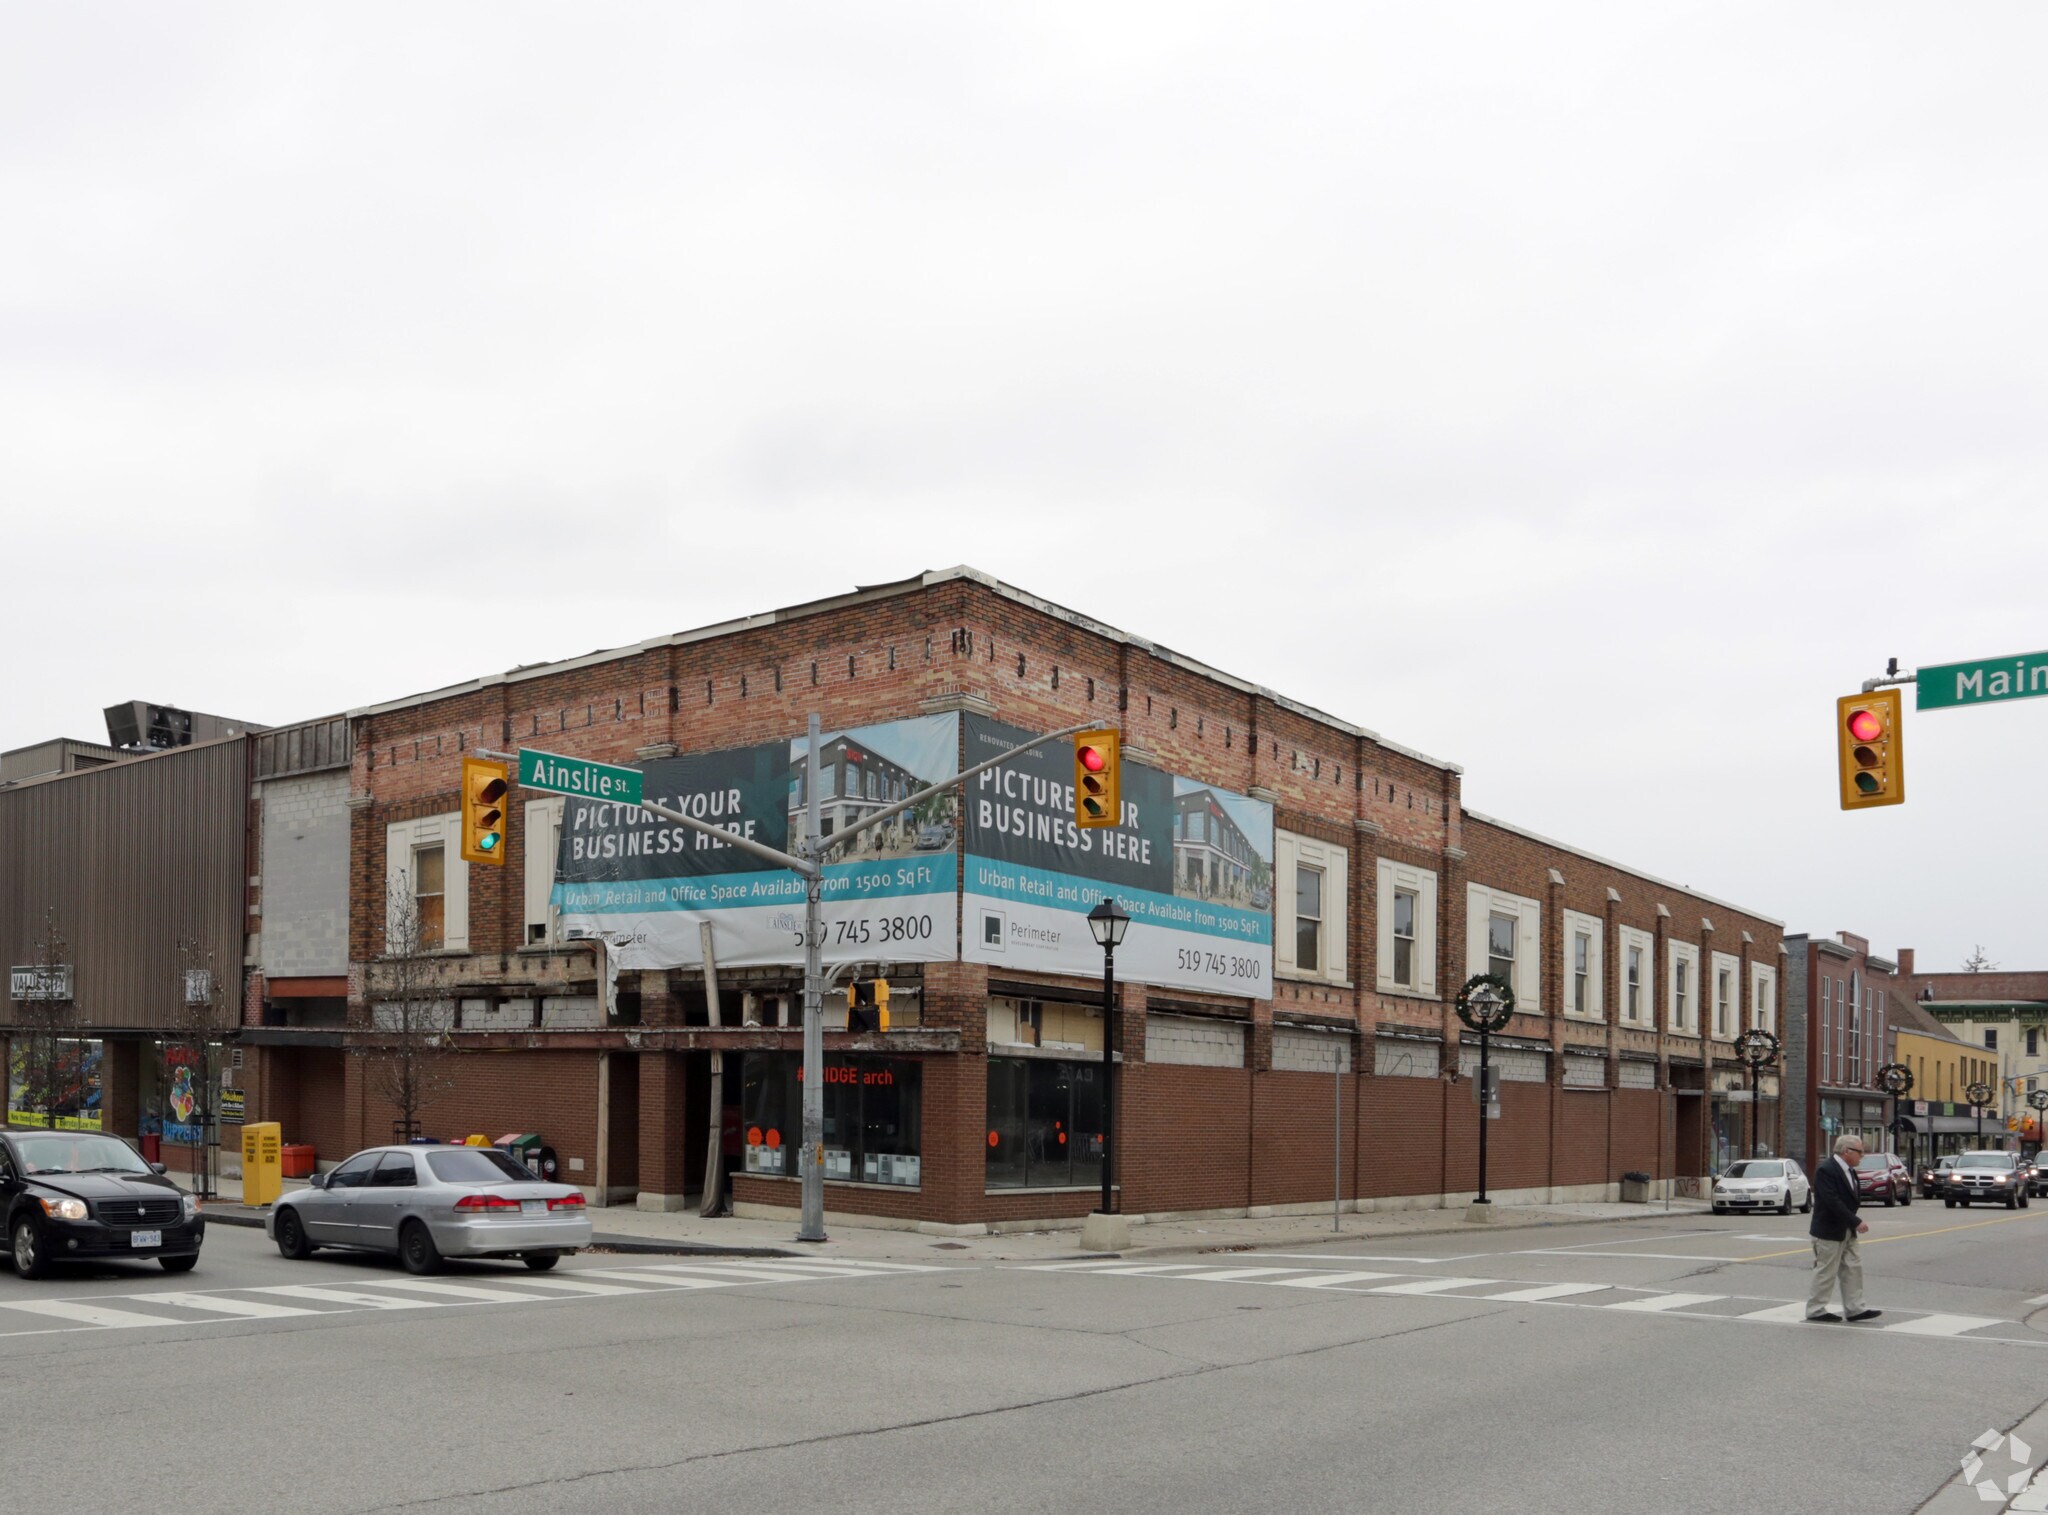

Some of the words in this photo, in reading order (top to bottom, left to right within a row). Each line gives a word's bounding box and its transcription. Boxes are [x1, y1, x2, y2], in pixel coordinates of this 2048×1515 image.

[1956, 661, 2048, 700] Main
[980, 733, 1014, 750] RENOVATED
[532, 759, 612, 796] Ainslie
[614, 780, 630, 794] St.
[979, 762, 1076, 814] PICTURE
[677, 788, 742, 819] YOUR
[573, 827, 685, 861] BUSINESS
[979, 799, 1093, 852] BUSINESS
[1102, 829, 1151, 865] HERE
[566, 891, 600, 906] Urban
[605, 889, 642, 905] Retail
[644, 888, 666, 903] and
[670, 885, 707, 901] Office
[710, 883, 748, 902] Space
[750, 878, 807, 897] Availabl
[855, 875, 892, 892] 1500
[979, 867, 1015, 890] Urban
[1019, 875, 1054, 898] Retail
[1057, 883, 1078, 902] and
[1117, 894, 1146, 915] Space
[1148, 901, 1192, 922] Available
[1194, 909, 1216, 926] from
[1218, 917, 1239, 932] 1500
[835, 919, 870, 945] 745
[878, 914, 932, 943] 3800
[1011, 922, 1061, 943] Perimeter
[1178, 948, 1201, 972] 519
[1205, 952, 1226, 975] 745
[1230, 956, 1260, 980] 3800
[863, 1069, 893, 1085] arch
